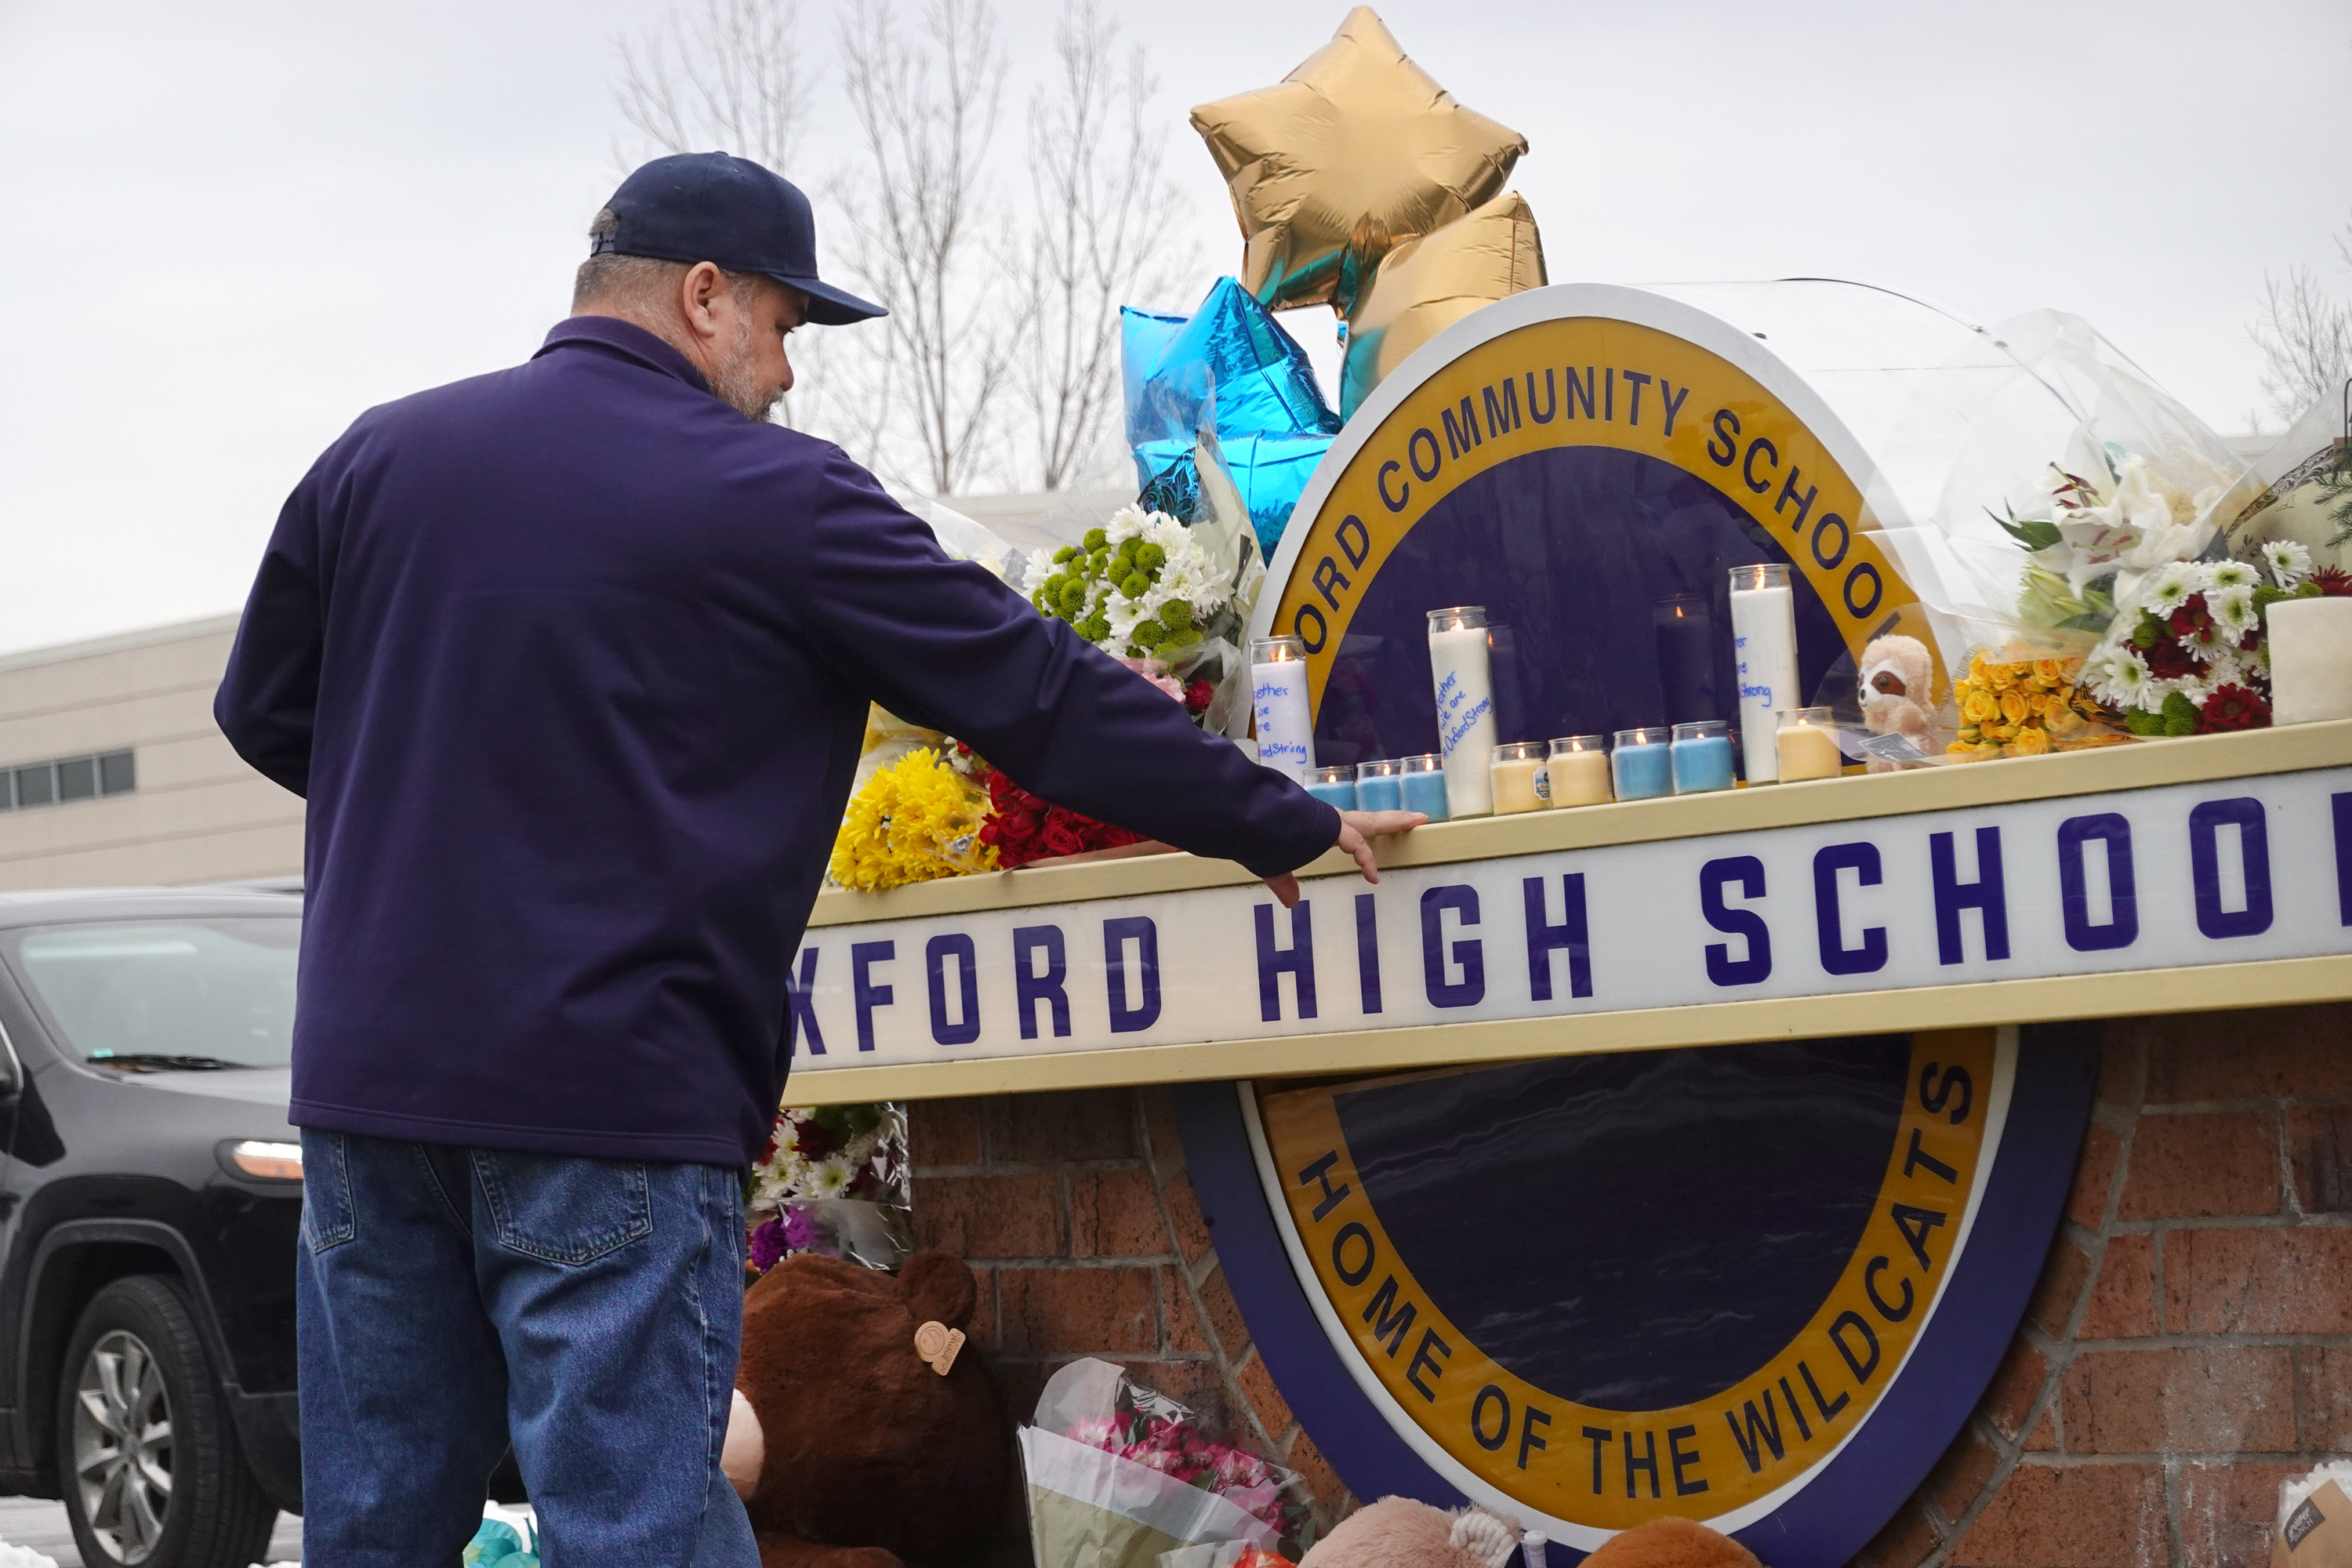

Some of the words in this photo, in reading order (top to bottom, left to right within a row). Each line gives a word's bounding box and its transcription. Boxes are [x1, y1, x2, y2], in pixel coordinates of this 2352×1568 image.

[1294, 514, 1370, 655] ORD
[1377, 366, 1690, 513] COMMUNITY
[1254, 682, 1289, 707] gether
[1436, 671, 1456, 717] gether
[1450, 691, 1466, 708] are
[786, 916, 1162, 1056] XFORD
[1254, 873, 1593, 1022] HIGH
[1299, 1149, 1452, 1404] HOME
[1472, 1385, 1552, 1470] OF
[1582, 1425, 1709, 1499] THE
[1726, 1062, 1973, 1474] WILDCATS
